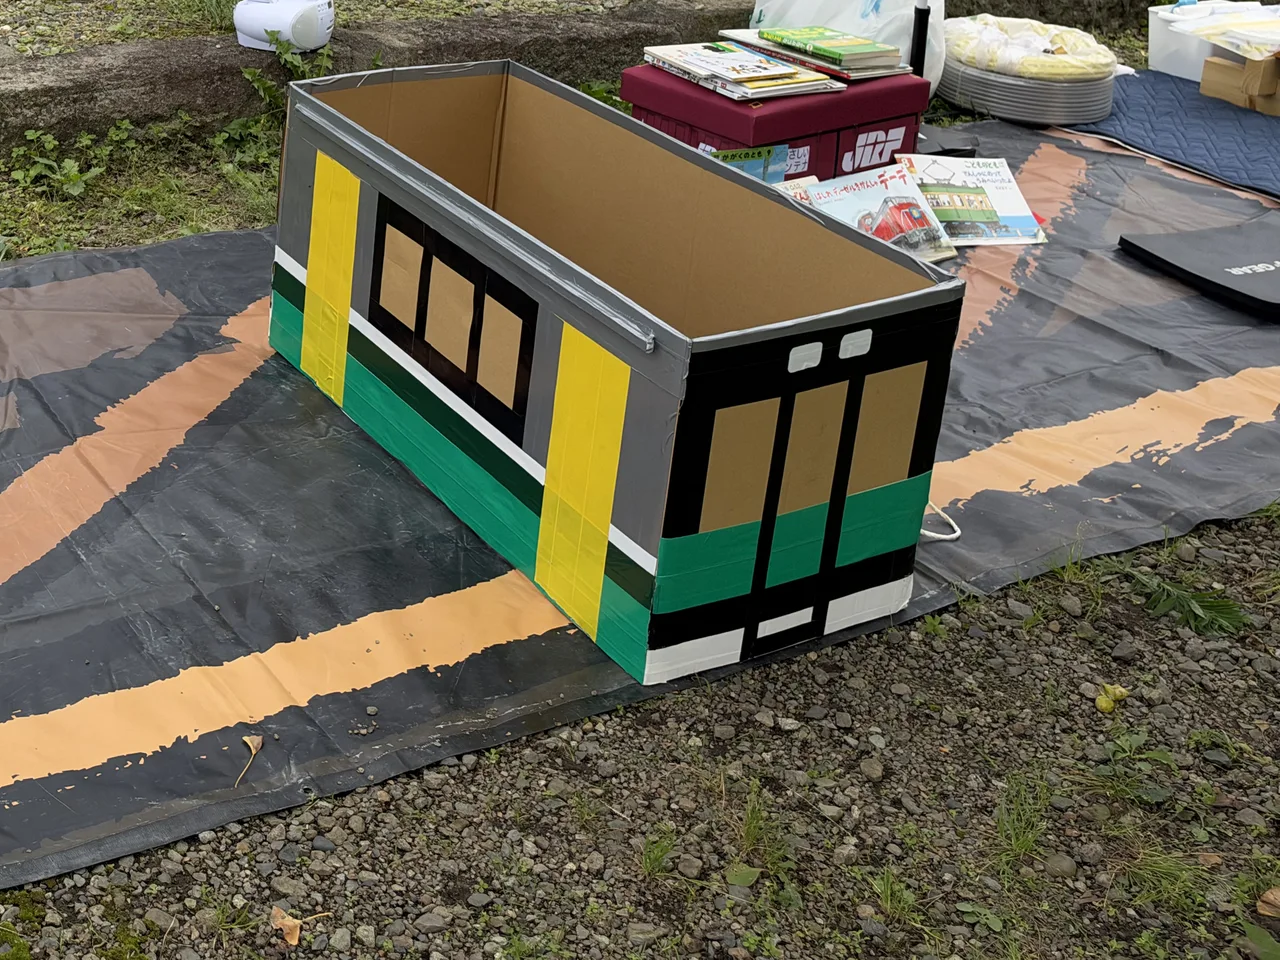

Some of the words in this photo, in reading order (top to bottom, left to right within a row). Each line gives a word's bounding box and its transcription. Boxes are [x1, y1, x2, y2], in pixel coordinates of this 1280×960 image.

[722, 151, 762, 161] かがくのとも
[841, 126, 906, 172] JRF
[964, 160, 1000, 169] こどものとも
[878, 167, 908, 190] デーデ
